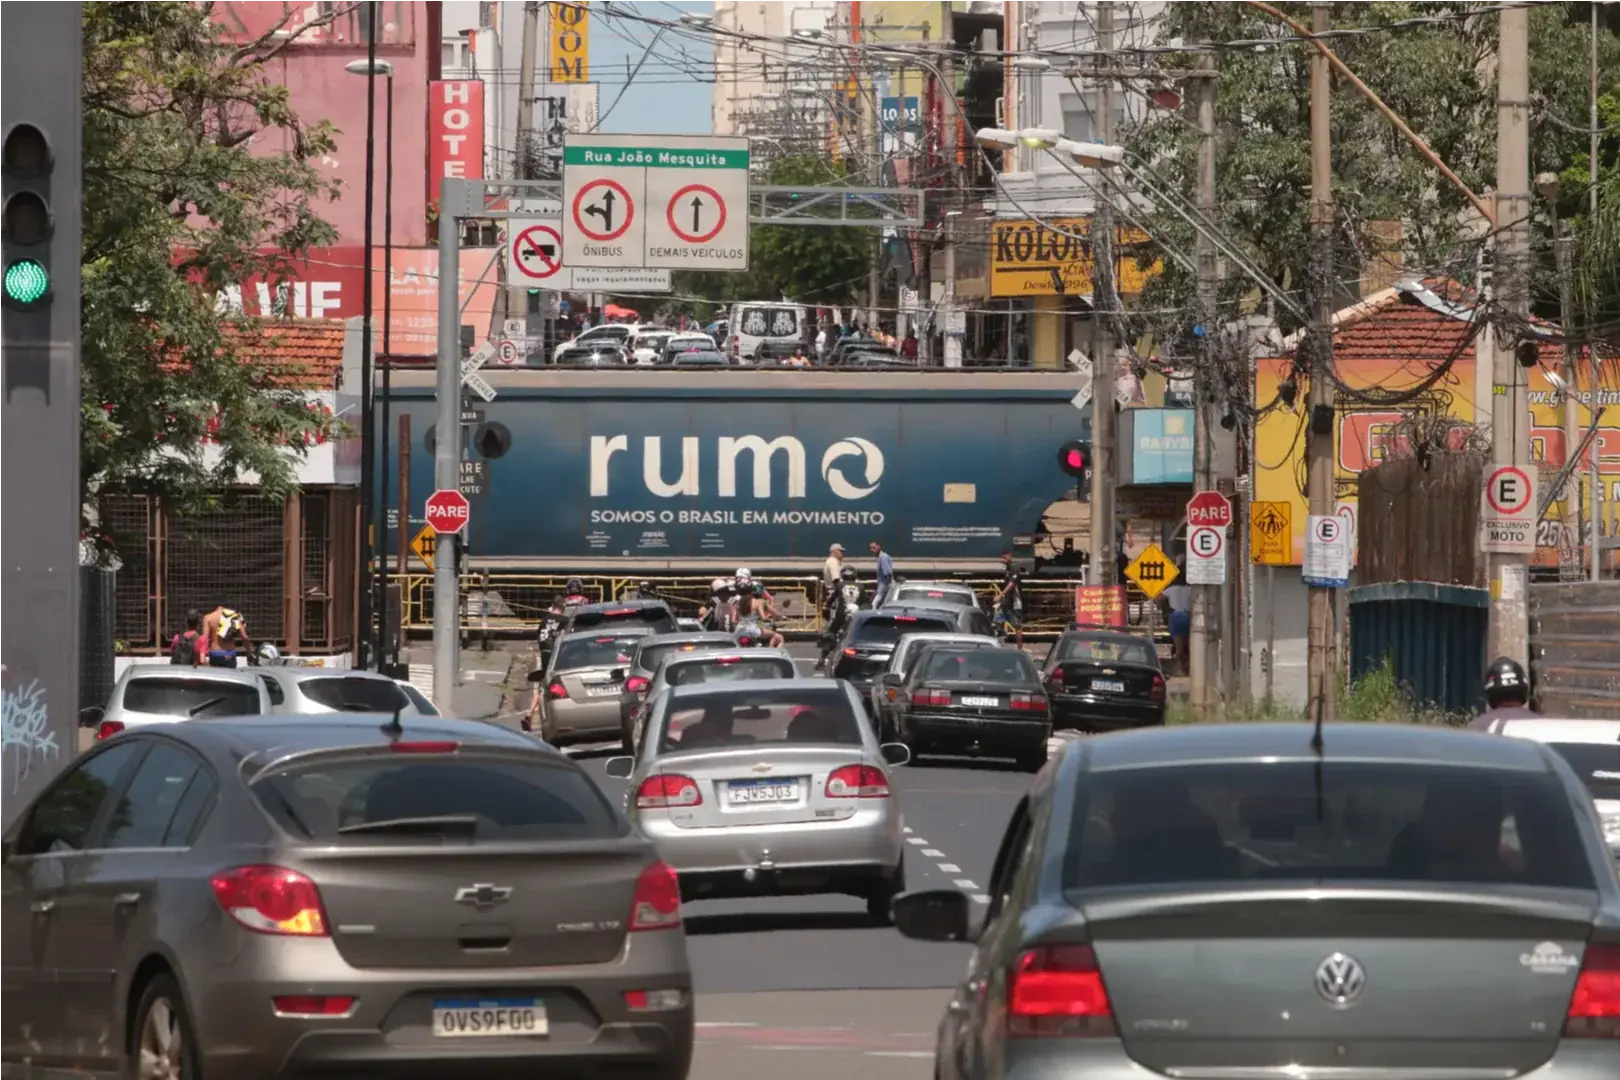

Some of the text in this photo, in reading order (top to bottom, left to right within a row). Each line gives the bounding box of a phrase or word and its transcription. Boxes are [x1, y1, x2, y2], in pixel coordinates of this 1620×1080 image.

[585, 151, 727, 166] Rua João Mesquita
[582, 244, 623, 257] ÔNIBUS
[650, 247, 689, 257] DEMAIS
[503, 346, 511, 359] E
[589, 434, 885, 500] rumo
[1500, 479, 1517, 503] E
[428, 505, 467, 518] PARE
[591, 510, 885, 526] SOMOS O BRASIL EM MOVIMENTO
[1190, 506, 1229, 521] PARE
[1321, 523, 1334, 538] E
[1486, 521, 1530, 531] EXCLUSIVO
[1200, 534, 1212, 551] E
[1489, 531, 1525, 543] MOTO
